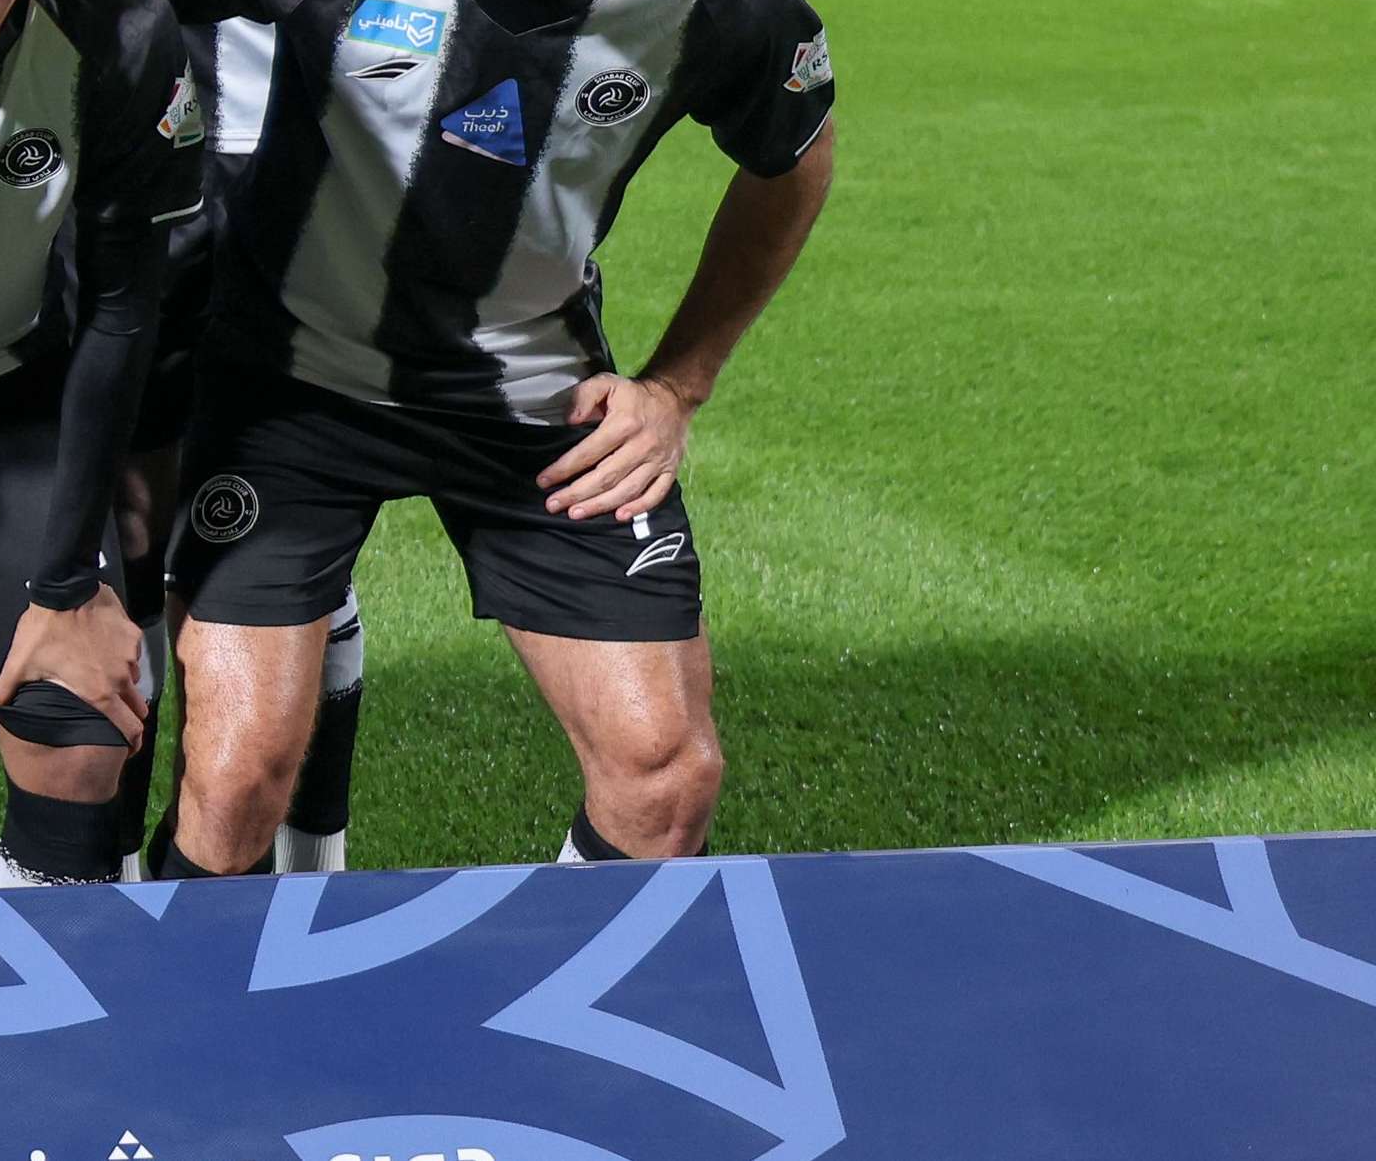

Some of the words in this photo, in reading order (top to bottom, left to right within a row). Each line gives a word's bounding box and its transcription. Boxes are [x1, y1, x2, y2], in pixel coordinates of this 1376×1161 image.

[594, 74, 624, 84] SHABAB
[464, 105, 509, 120] ذيب
[462, 120, 506, 133] Theeb
